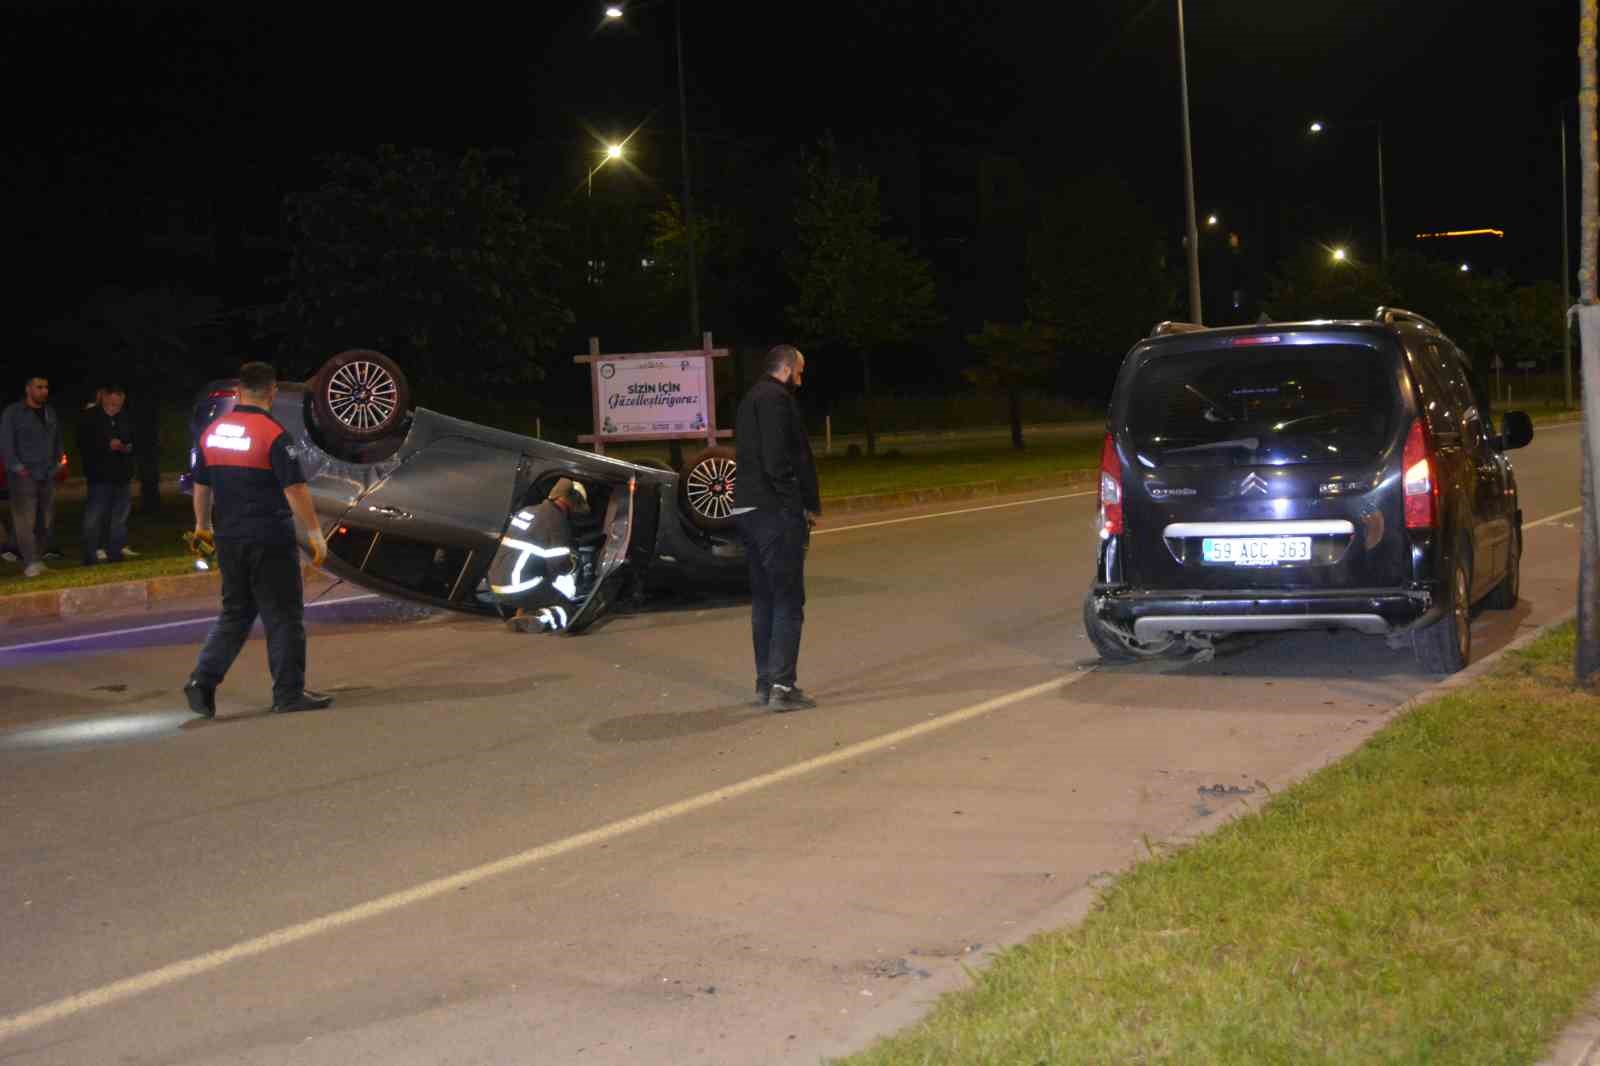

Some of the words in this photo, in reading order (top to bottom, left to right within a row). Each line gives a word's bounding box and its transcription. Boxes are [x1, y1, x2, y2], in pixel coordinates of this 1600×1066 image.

[658, 381, 681, 395] İÇİN
[1214, 543, 1231, 559] 59
[1240, 542, 1268, 559] ACC
[1279, 542, 1307, 558] 363
